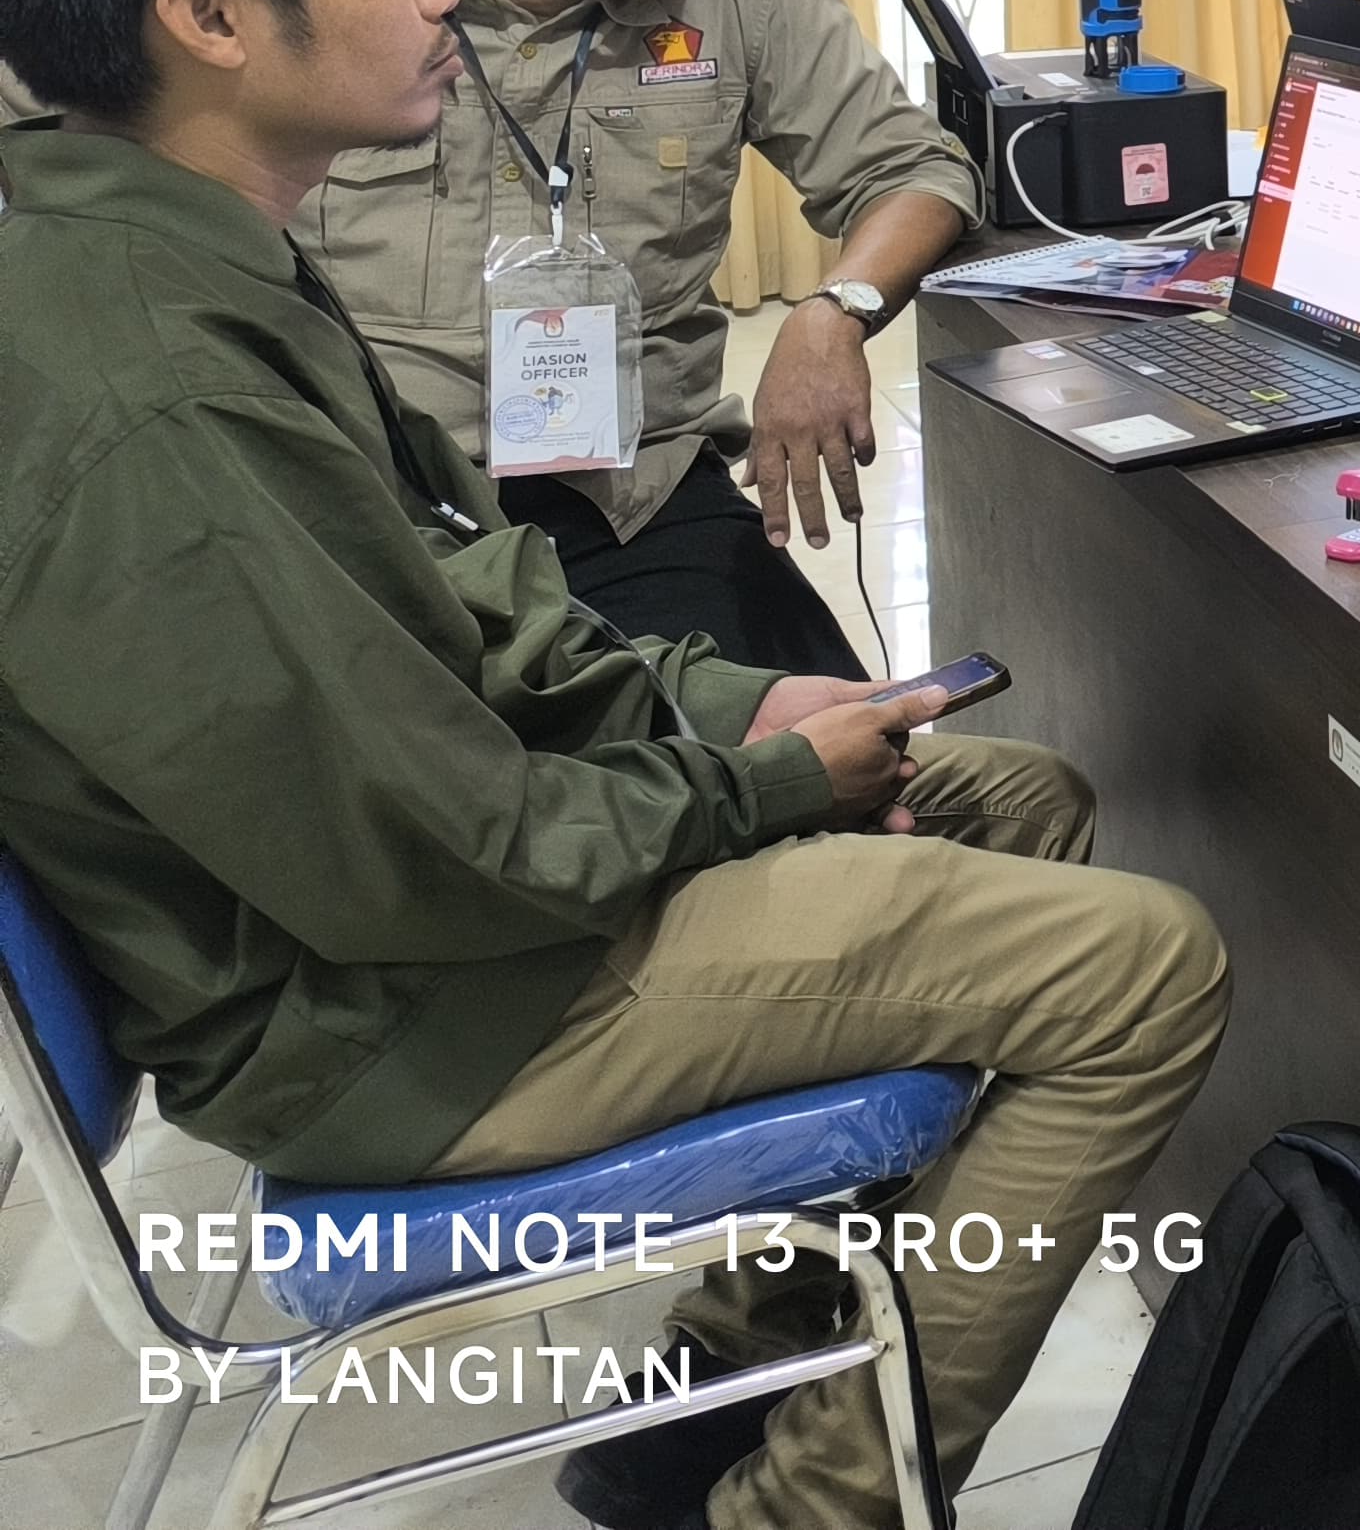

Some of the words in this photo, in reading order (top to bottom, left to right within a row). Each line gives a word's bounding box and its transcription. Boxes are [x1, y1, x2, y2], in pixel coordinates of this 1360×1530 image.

[645, 62, 713, 78] GERINDRA
[522, 352, 588, 367] LIASION
[520, 366, 588, 381] OFFICER
